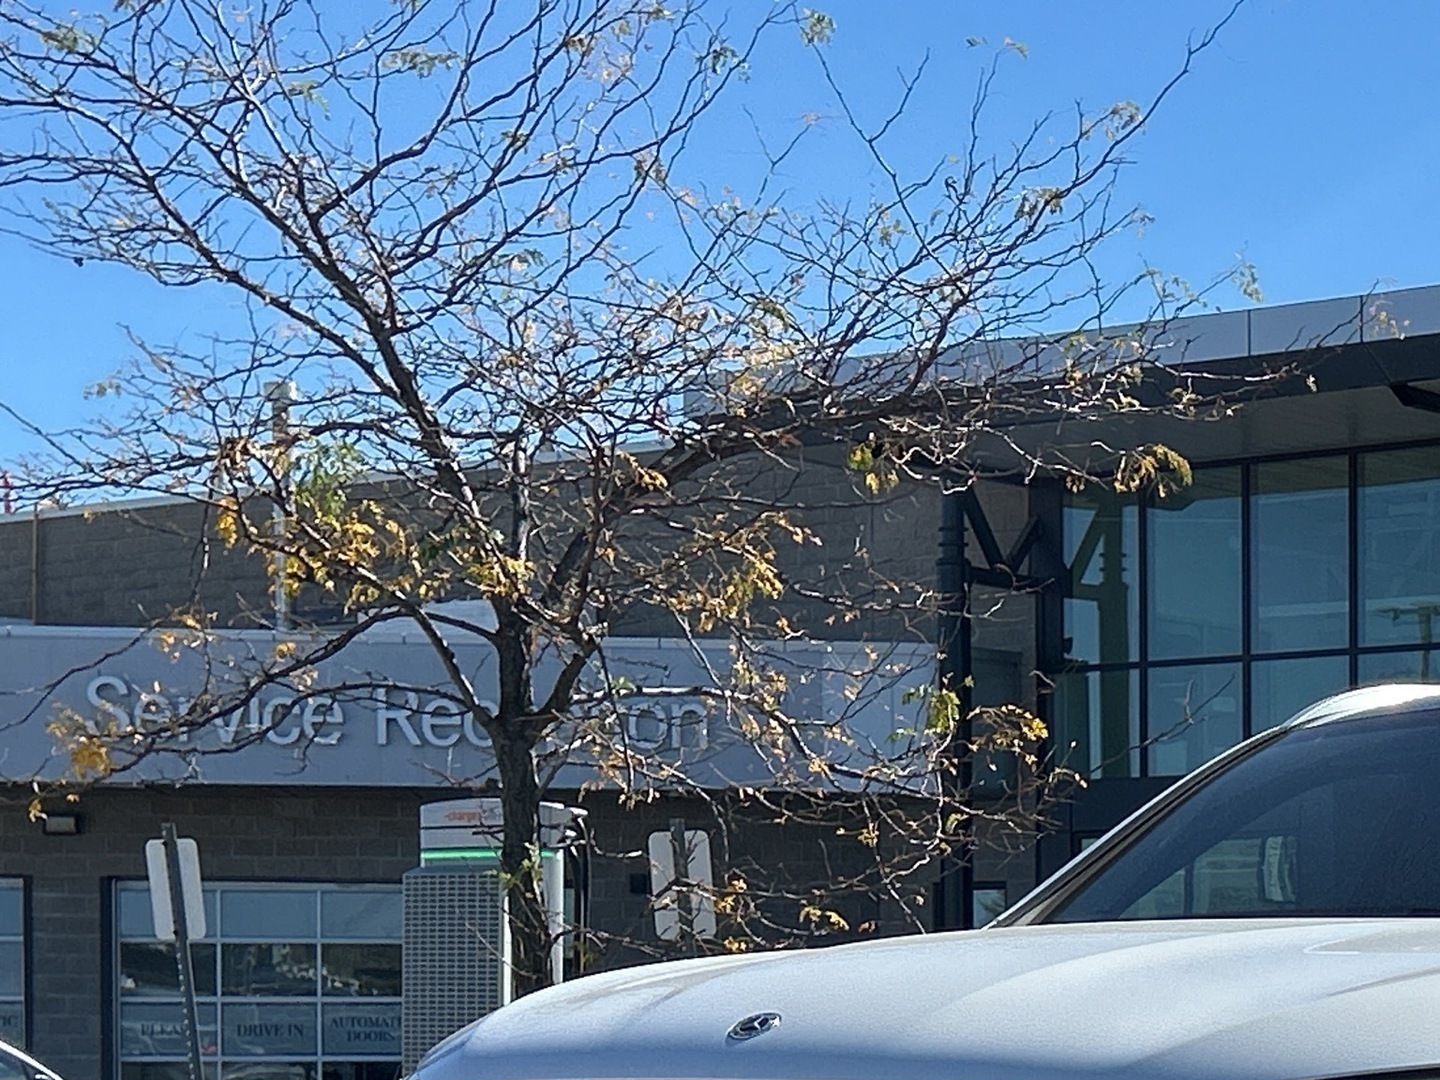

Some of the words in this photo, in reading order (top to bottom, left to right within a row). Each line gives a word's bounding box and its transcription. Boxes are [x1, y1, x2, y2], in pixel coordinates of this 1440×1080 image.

[237, 1022, 286, 1038] DRIVE
[289, 1022, 304, 1038] IN
[347, 1030, 396, 1042] DOORS
